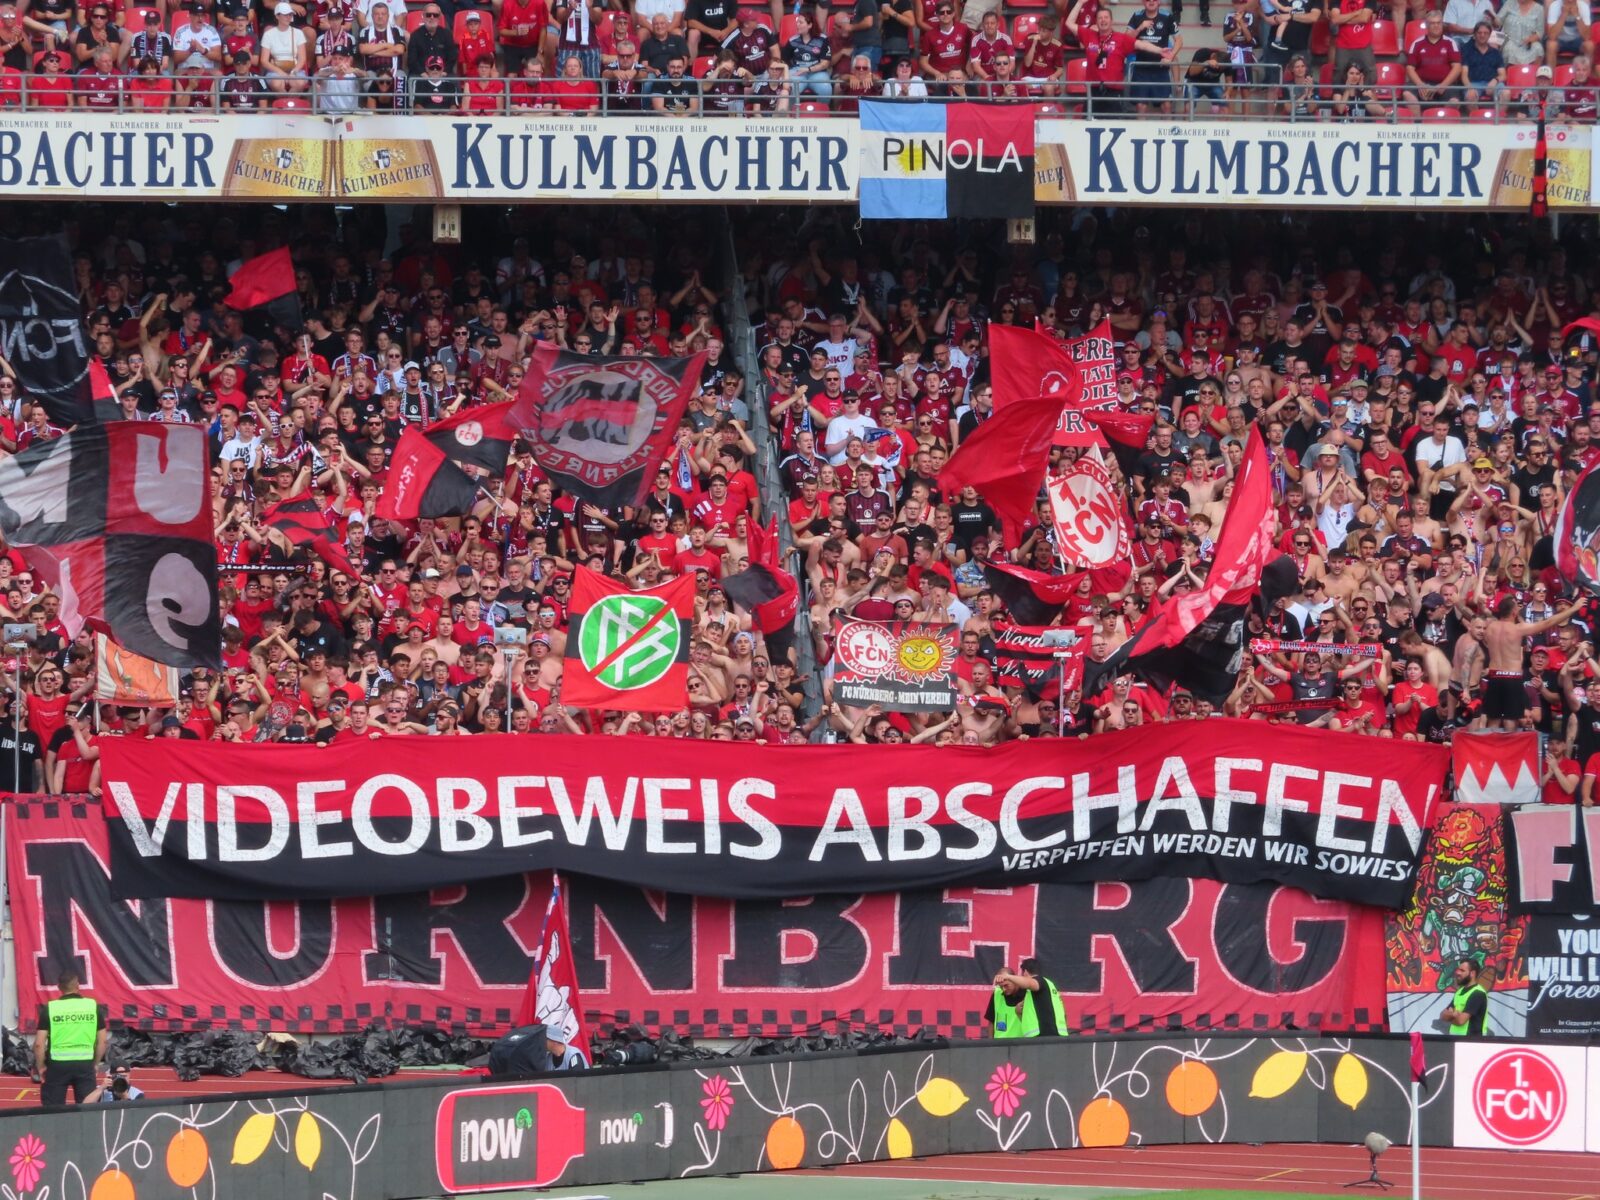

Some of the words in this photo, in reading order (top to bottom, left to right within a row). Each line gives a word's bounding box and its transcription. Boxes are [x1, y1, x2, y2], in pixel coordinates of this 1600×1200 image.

[704, 7, 724, 16] CLUB
[55, 120, 73, 129] BIER
[109, 120, 160, 129] KULMBACHER
[166, 121, 184, 130] BIER
[524, 123, 574, 132] KULMBACHER
[580, 124, 598, 132] BIER
[634, 123, 684, 133] KULMBACHER
[690, 124, 708, 133] BIER
[744, 124, 794, 133] KULMBACHER
[800, 125, 818, 134] BIER
[1213, 128, 1231, 137] BIER
[1267, 128, 1317, 138] KULMBACHER
[1322, 129, 1341, 139] BIER
[1376, 130, 1427, 139] KULMBACHER
[1432, 131, 1451, 140] BIER
[450, 122, 851, 192] KULMBACHER
[882, 136, 1023, 174] PINOLA
[1083, 126, 1484, 198] KULMBACHER
[233, 159, 325, 194] KULMBACHER
[340, 161, 433, 195] KULMBACHER
[1058, 480, 1087, 511] 1.
[1058, 491, 1118, 554] FCN
[854, 644, 888, 662] FCN
[865, 632, 878, 647] 1.
[107, 772, 783, 863] VIDEOBEWEIS
[808, 755, 1438, 863] ABSCHAFFEN
[1001, 834, 1146, 872] VERPFIFFEN
[1152, 832, 1257, 859] WERDEN
[1263, 840, 1309, 866] WIR
[1314, 850, 1415, 882] SOWIES
[1527, 956, 1583, 982] WILL
[65, 1013, 95, 1022] POWER
[1509, 1057, 1530, 1088] 1.
[1485, 1088, 1553, 1121] FCN
[460, 1116, 526, 1163] now
[600, 1116, 639, 1145] now
